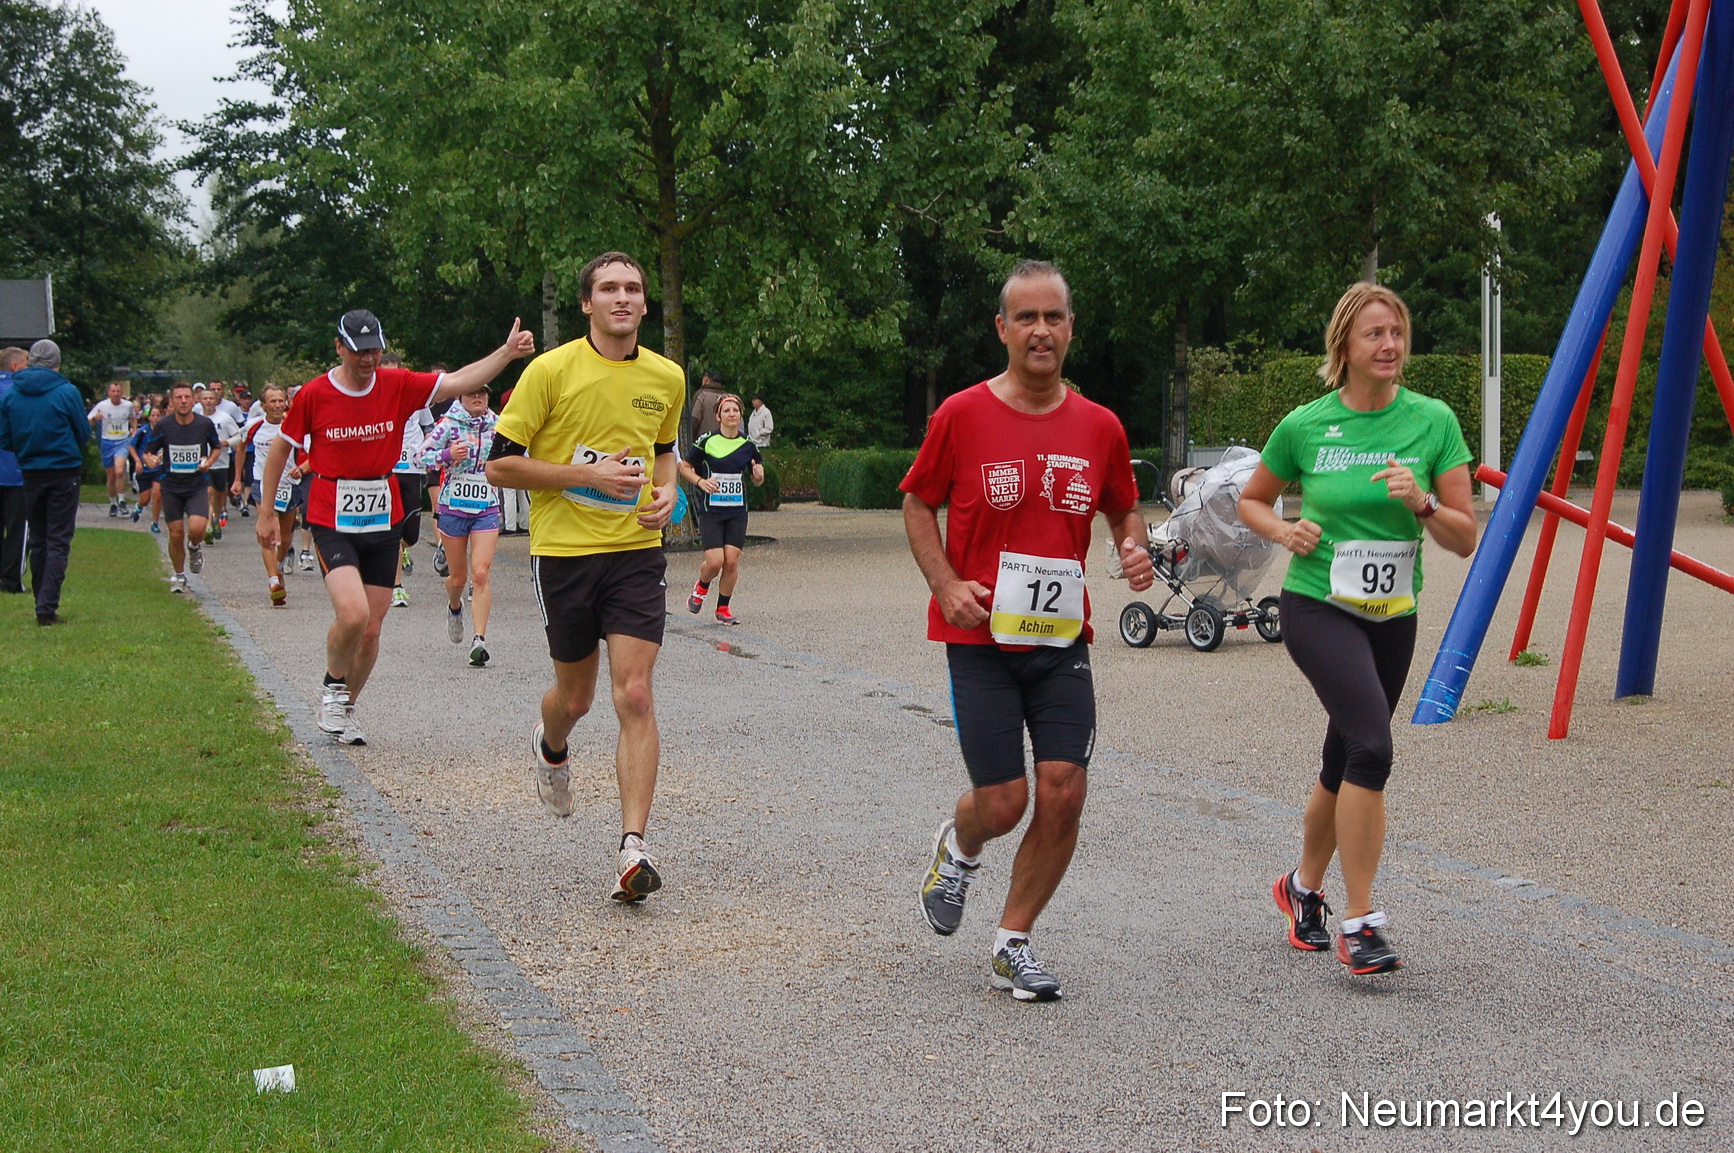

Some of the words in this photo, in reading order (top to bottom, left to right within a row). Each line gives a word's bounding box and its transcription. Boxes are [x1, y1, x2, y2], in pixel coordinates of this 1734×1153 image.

[326, 422, 385, 439] NEUMARKT
[172, 452, 198, 463] 2589
[988, 467, 1019, 478] IMMER
[1046, 461, 1084, 472] STADTLAUF
[987, 475, 1021, 485] WIEDER
[454, 482, 488, 499] 3009
[990, 483, 1019, 495] NEU
[342, 493, 387, 513] 2374
[991, 494, 1019, 503] MARKT
[352, 517, 376, 526] Jürgen
[1001, 561, 1032, 574] PARTL
[1034, 566, 1073, 577] Neumarkt
[1362, 562, 1396, 594] 93
[1027, 579, 1062, 613] 12
[1018, 619, 1054, 634] Achim
